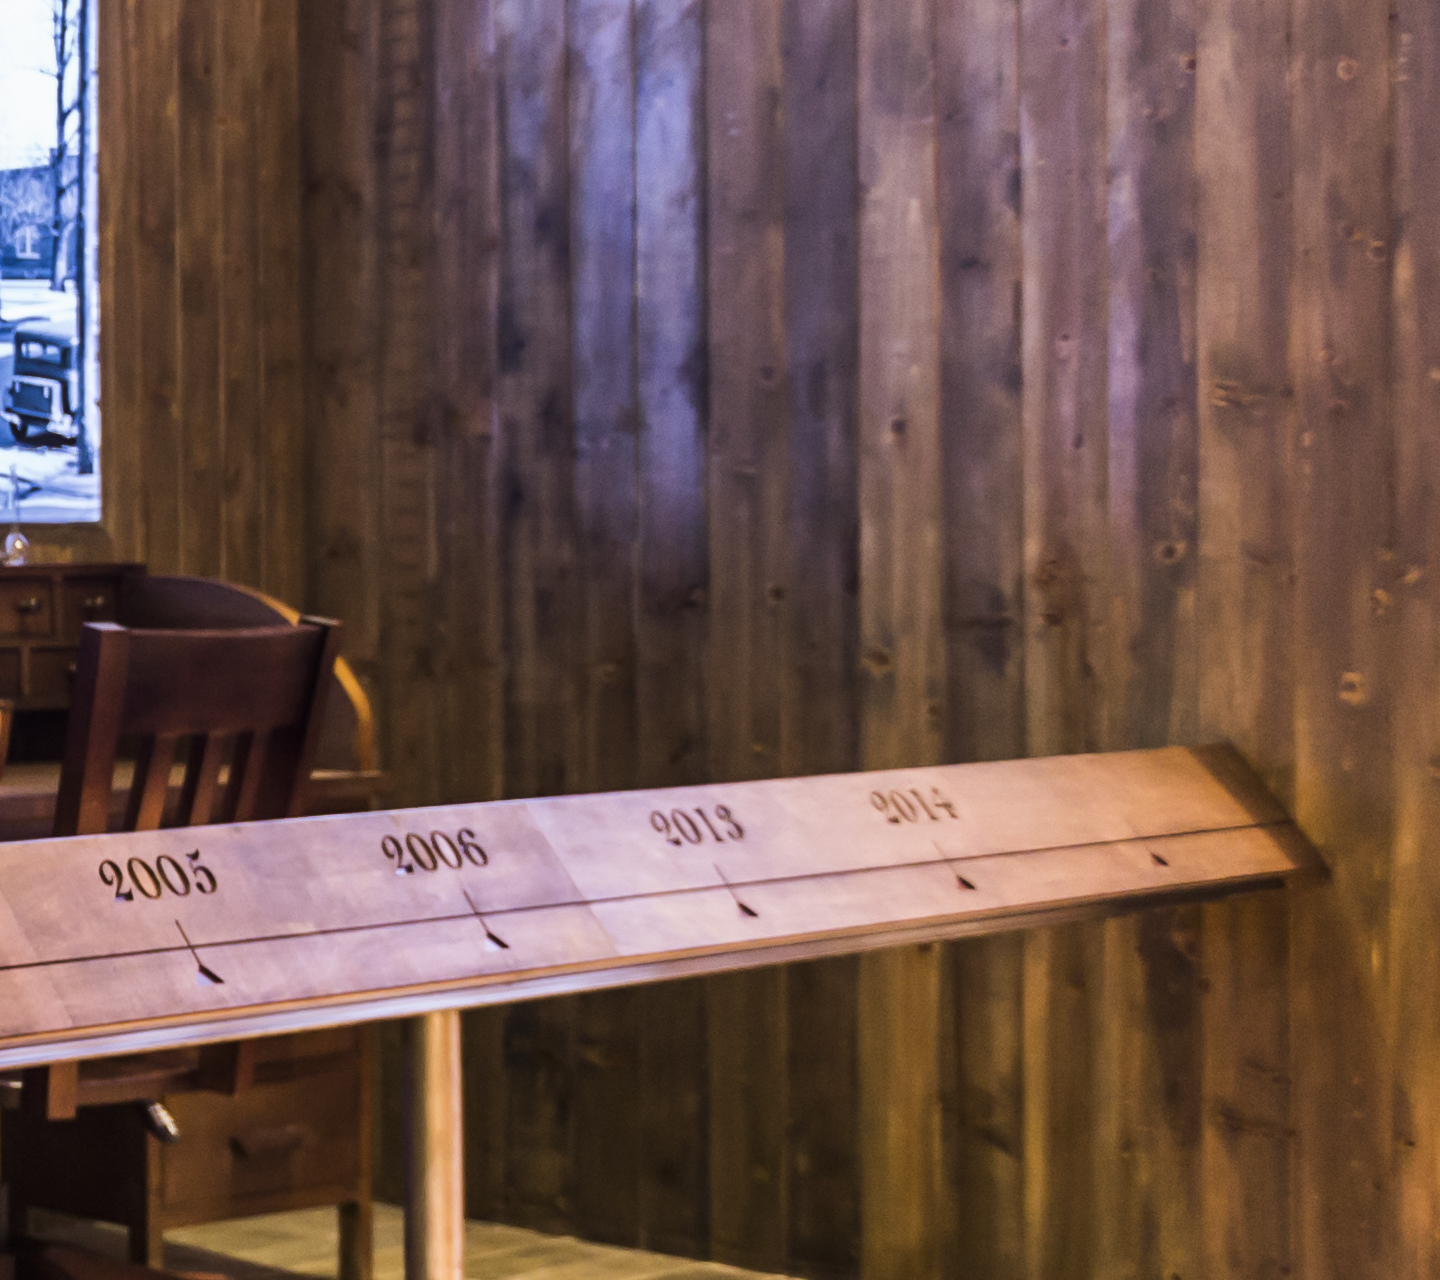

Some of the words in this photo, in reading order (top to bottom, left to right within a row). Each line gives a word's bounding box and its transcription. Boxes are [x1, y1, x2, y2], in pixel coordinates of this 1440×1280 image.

[650, 803, 747, 850] 2013
[871, 786, 960, 827] 2014
[98, 849, 219, 905] 2005
[381, 827, 490, 878] 2006
